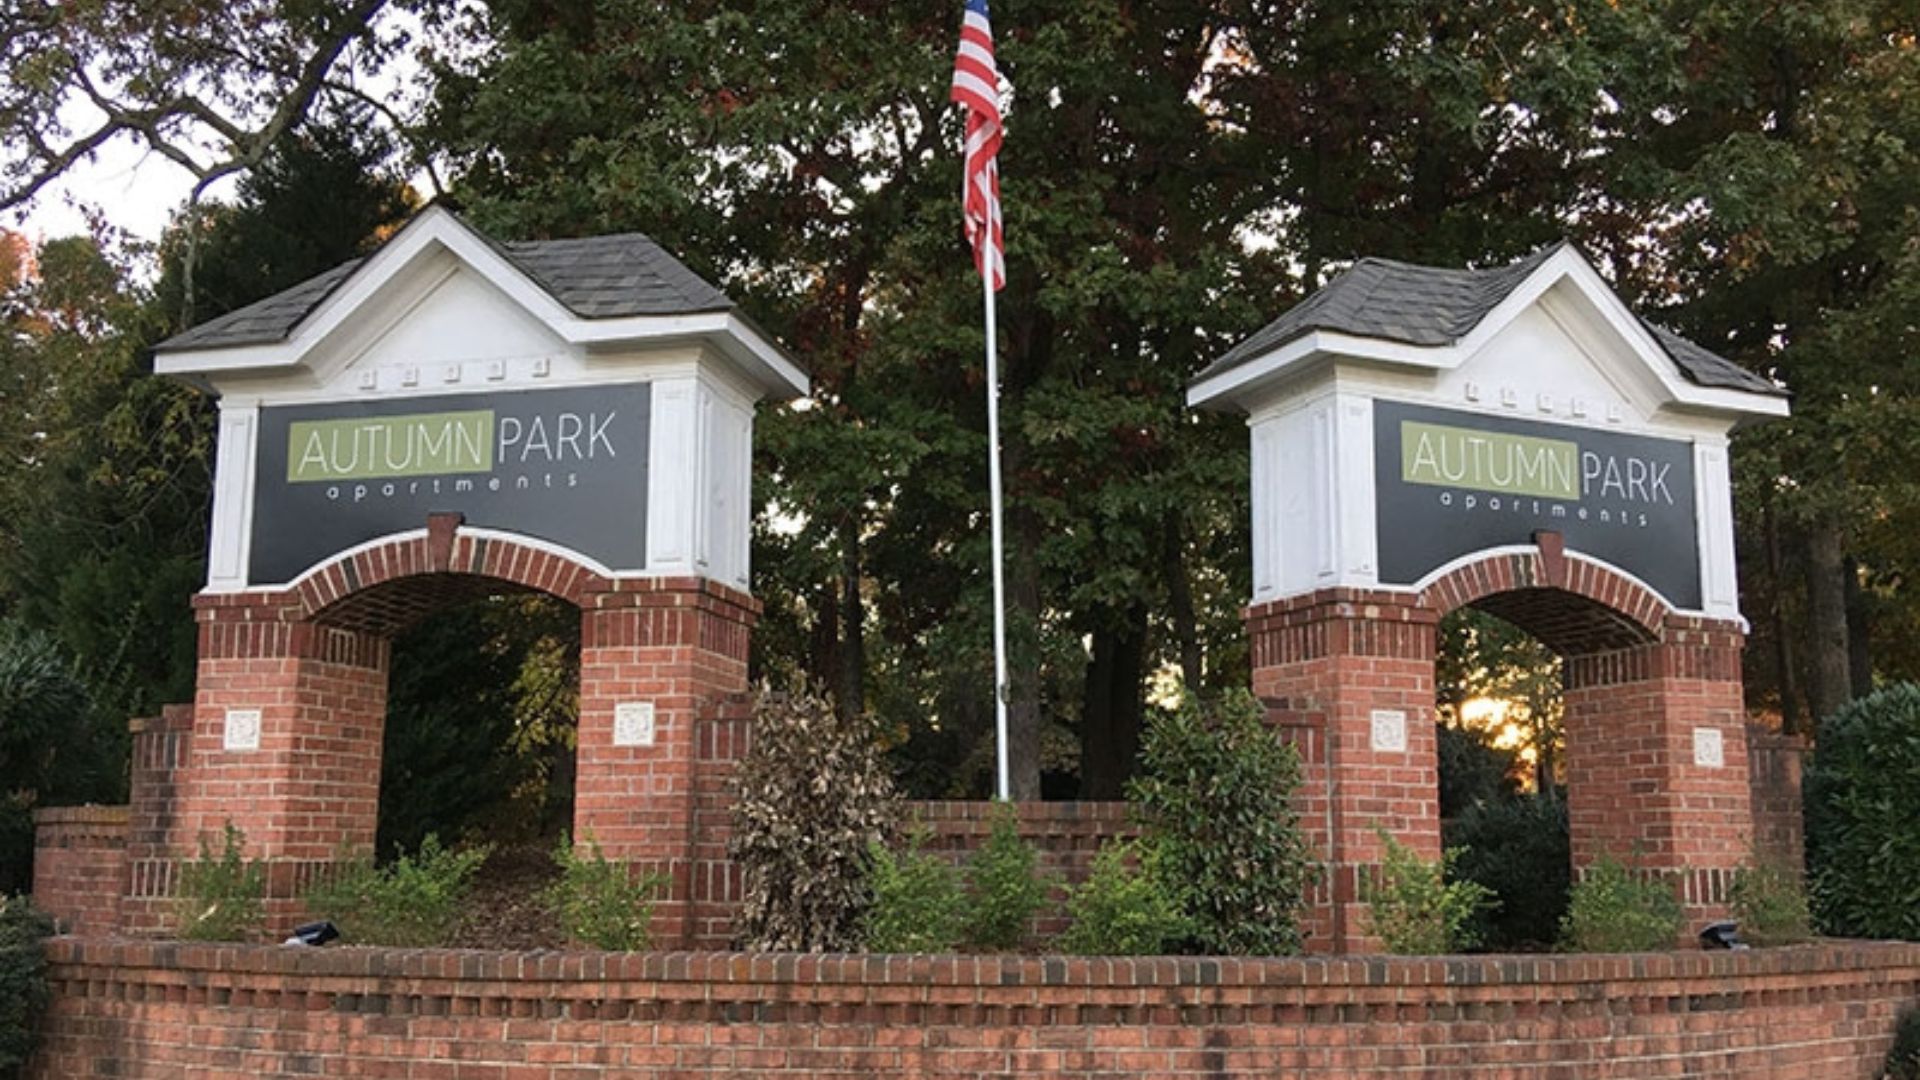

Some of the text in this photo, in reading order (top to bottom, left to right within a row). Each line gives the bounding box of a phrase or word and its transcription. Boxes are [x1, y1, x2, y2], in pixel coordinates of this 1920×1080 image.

[297, 411, 616, 474] AUTUMN PARK
[326, 472, 577, 502] apartments
[1410, 431, 1674, 505] AUTUMN PARK
[1439, 492, 1648, 527] apartments
